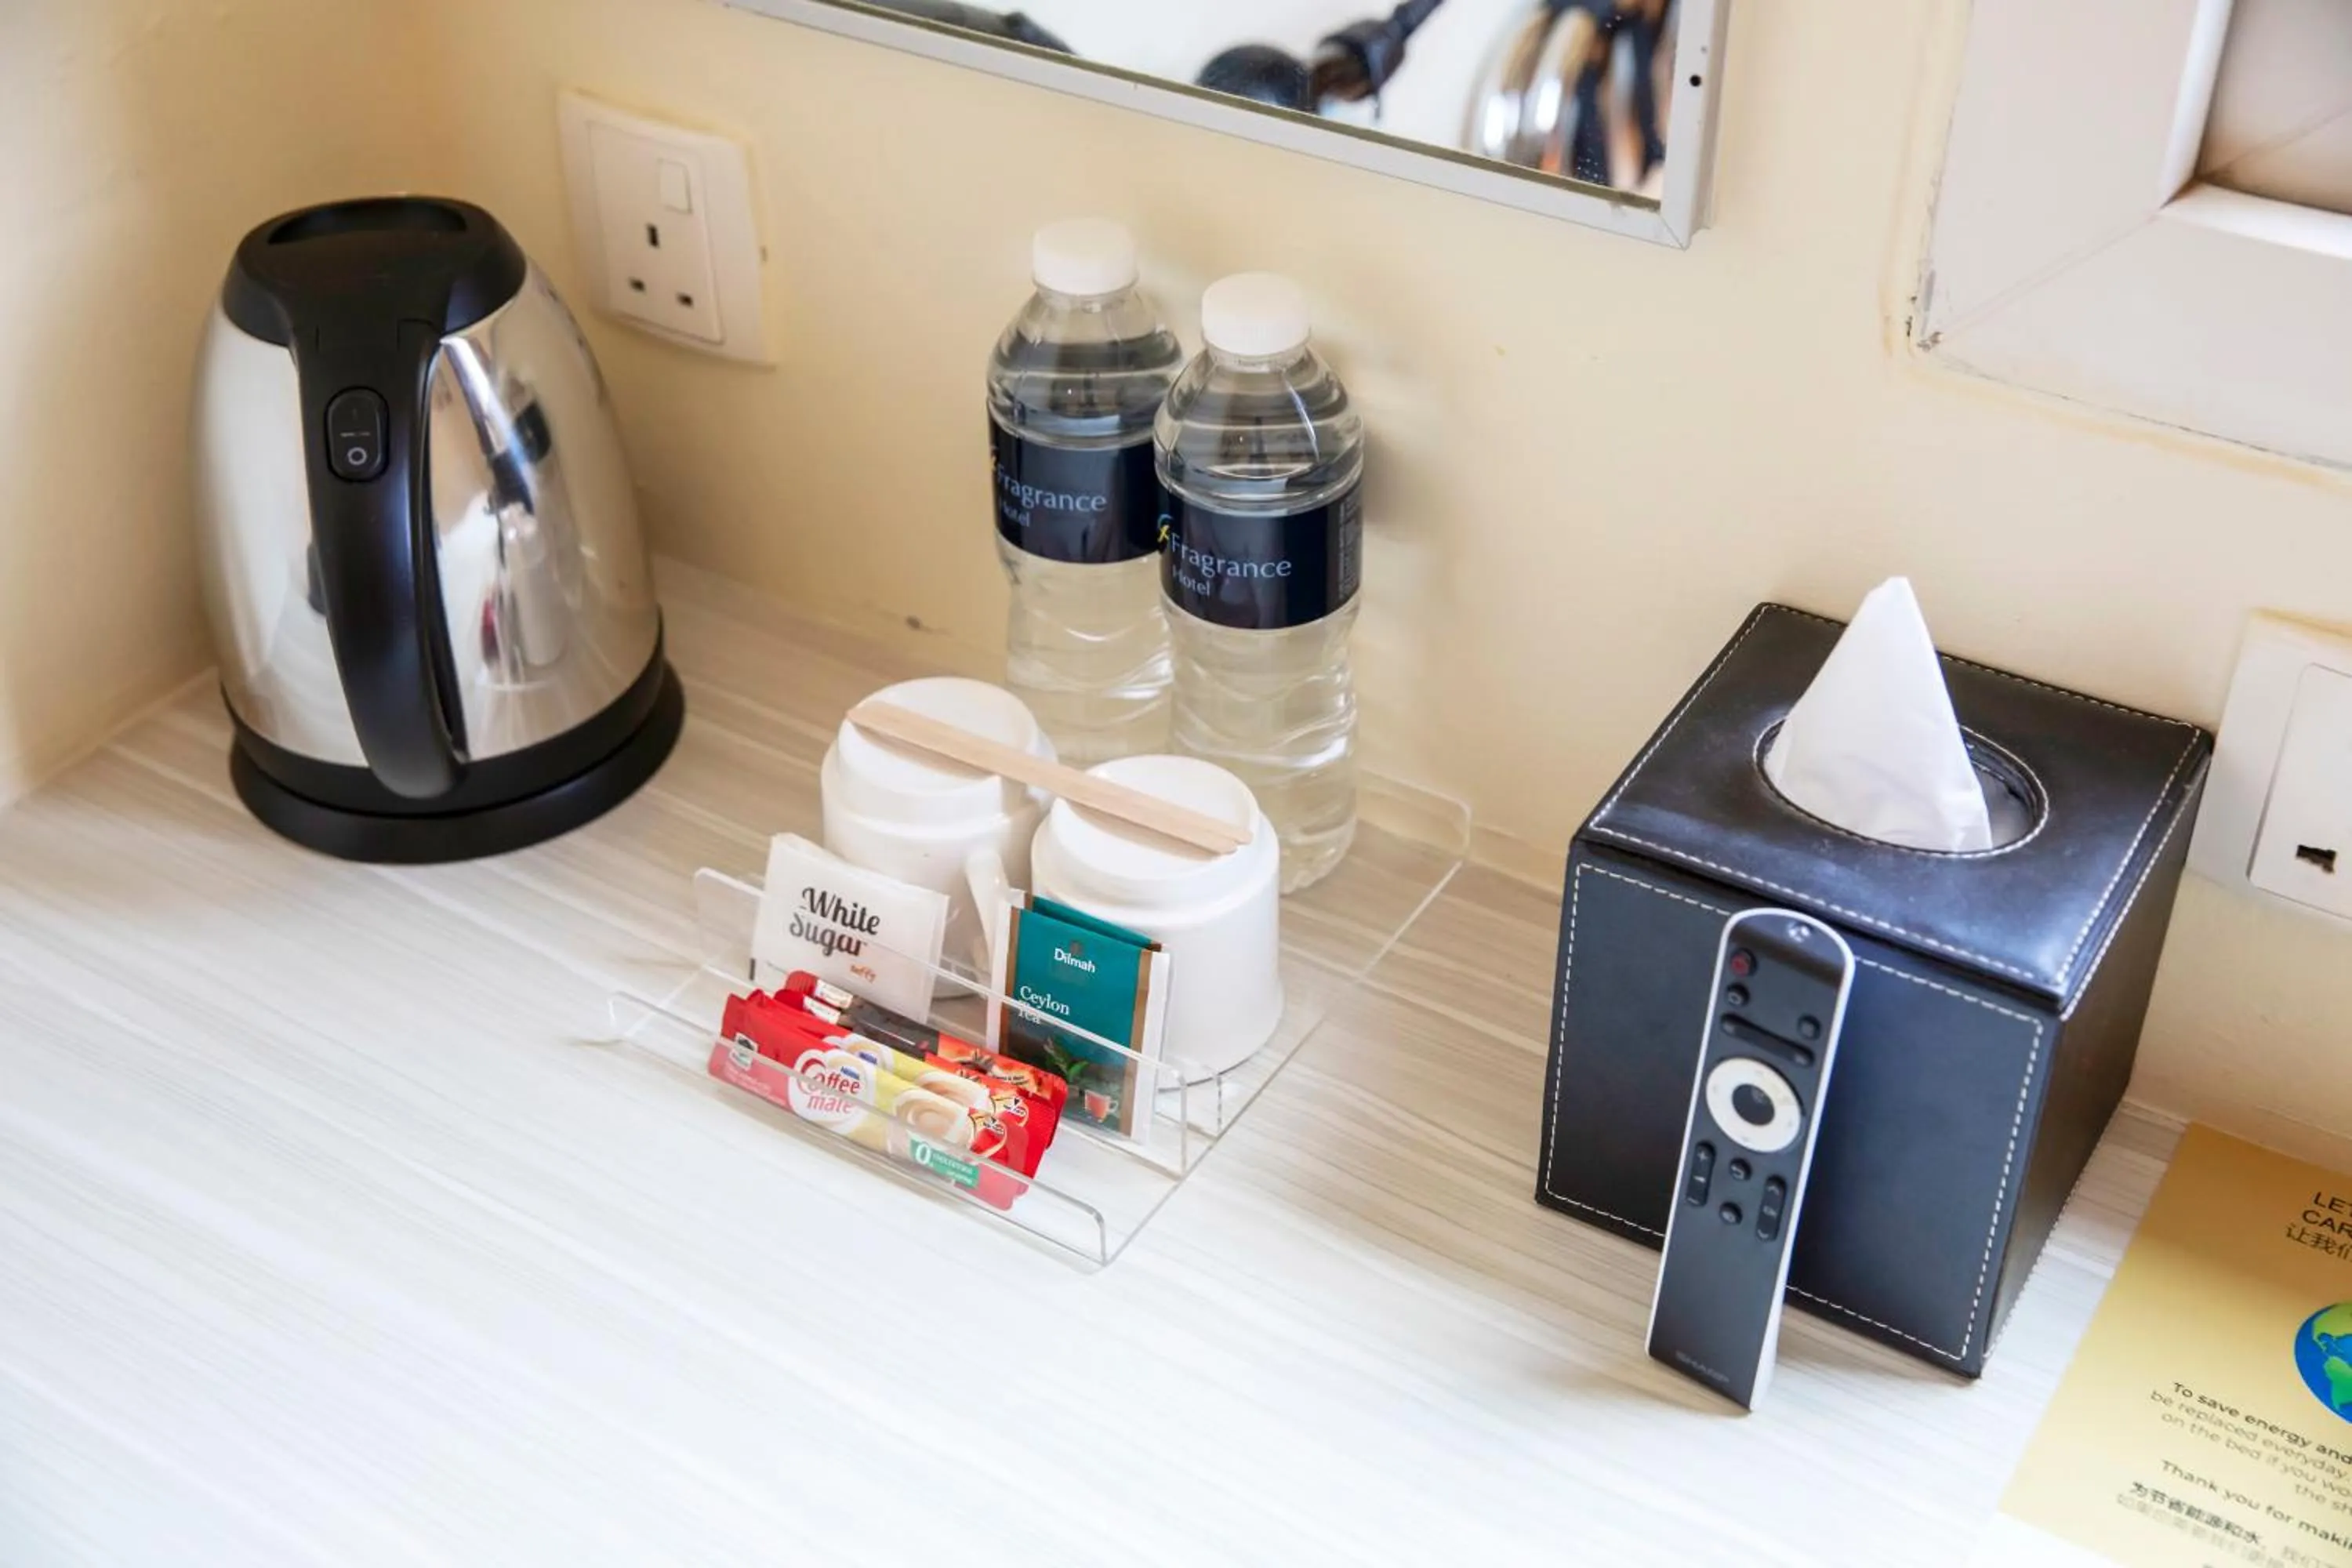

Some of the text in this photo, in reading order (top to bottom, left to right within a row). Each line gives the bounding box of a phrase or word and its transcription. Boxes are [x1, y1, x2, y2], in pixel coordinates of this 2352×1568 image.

[997, 463, 1107, 513] Fragrance
[1171, 532, 1292, 579] Fragrance
[1172, 564, 1210, 597] Hotel
[789, 912, 866, 957] Sugar
[801, 887, 880, 935] White
[1054, 947, 1096, 973] Dilmah
[1020, 985, 1070, 1016] Ceylon
[797, 1057, 861, 1095] Coffee
[2150, 1390, 2174, 1407] be
[2178, 1403, 2259, 1442] replaced
[2173, 1382, 2352, 1465] To save energy and
[2161, 1411, 2185, 1428] on
[2189, 1421, 2222, 1443] the
[2224, 1437, 2262, 1461] bed
[2280, 1462, 2317, 1483] you
[2161, 1459, 2219, 1493] Thank
[2222, 1488, 2260, 1511] you
[2265, 1504, 2294, 1524] for
[2294, 1483, 2328, 1505] the
